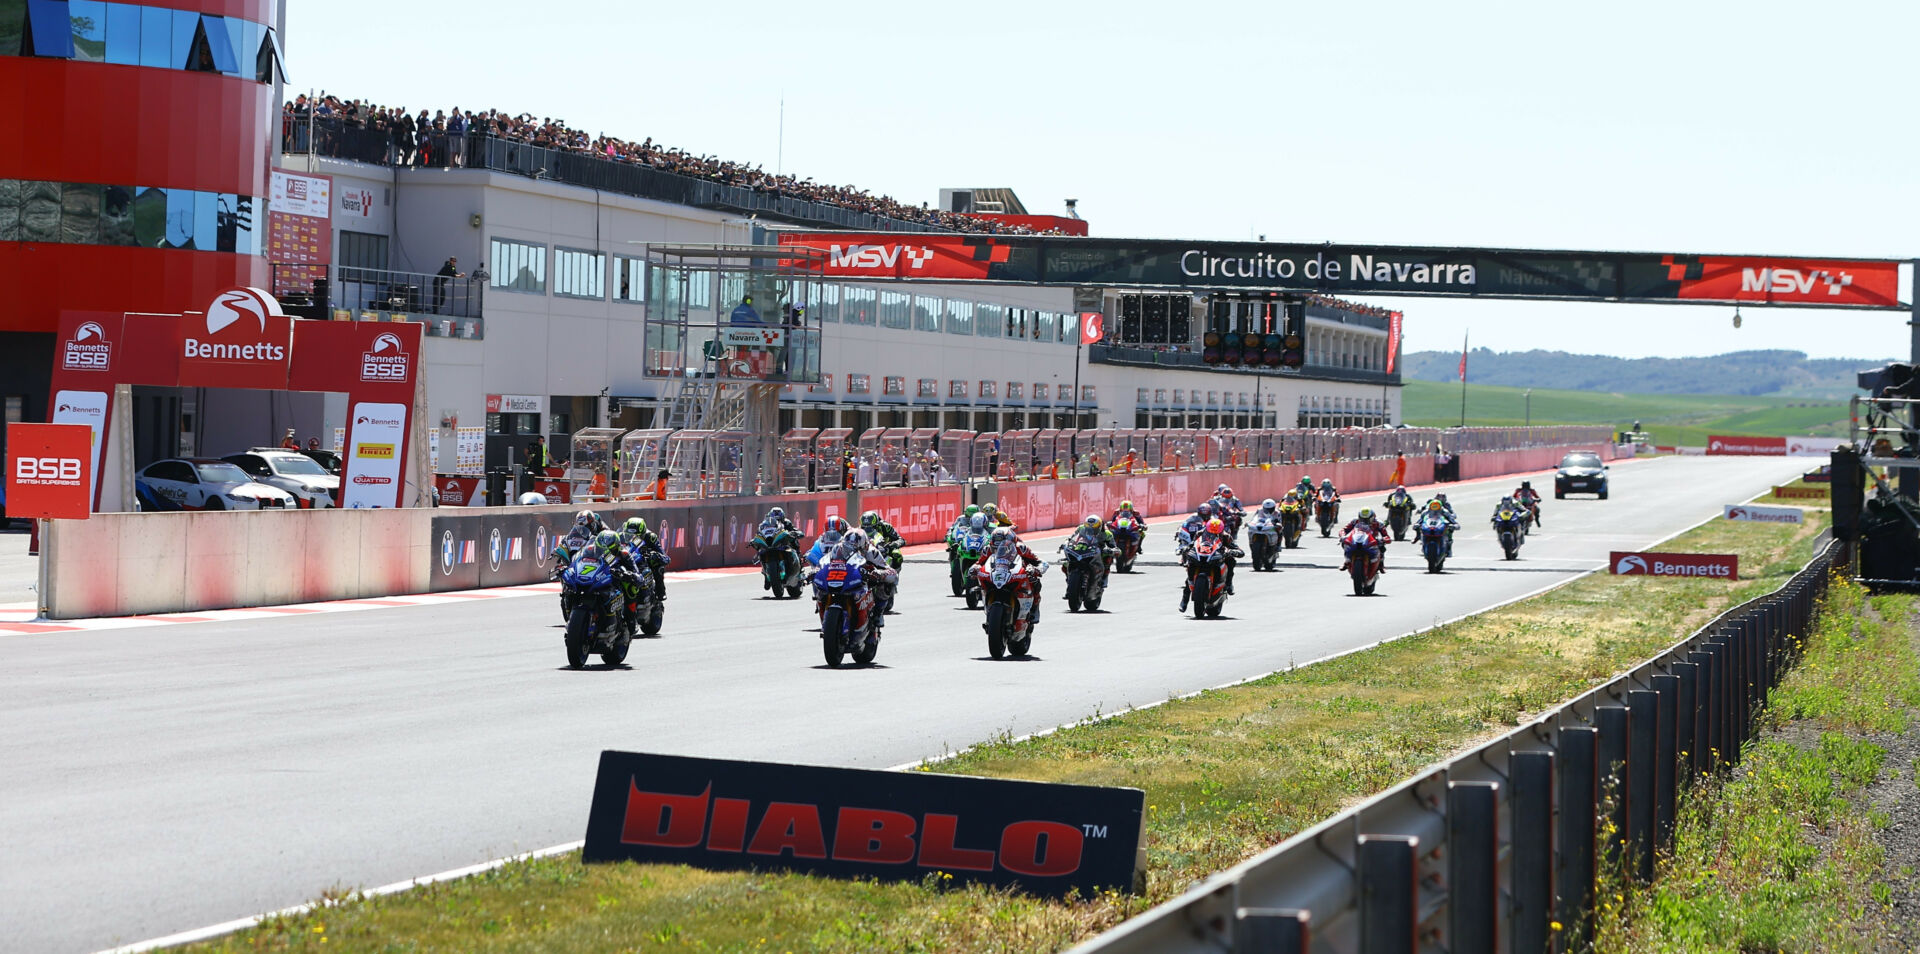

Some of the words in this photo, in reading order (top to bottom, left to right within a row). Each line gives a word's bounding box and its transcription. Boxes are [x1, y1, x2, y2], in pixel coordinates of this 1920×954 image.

[341, 197, 360, 211] Navarra
[830, 244, 902, 268] MSV
[1180, 250, 1296, 278] Circuito
[1304, 252, 1341, 280] de
[1350, 254, 1476, 285] Navarra
[1741, 267, 1818, 295] MSV
[729, 333, 760, 342] Navarra
[67, 342, 109, 353] Bennetts
[184, 338, 284, 361] Bennetts
[65, 351, 108, 365] BSB
[364, 353, 407, 364] Bennetts
[362, 363, 406, 377] BSB
[72, 406, 101, 414] Bennetts
[360, 446, 392, 456] PIRELLI
[16, 456, 82, 480] BSB
[354, 476, 389, 484] QUATTRO
[157, 486, 175, 498] Safety
[176, 488, 188, 498] Car
[442, 494, 463, 502] BSB
[866, 503, 956, 534] MOLOGATO
[1751, 511, 1798, 523] Bennetts
[579, 565, 597, 575] 7
[1654, 561, 1730, 576] Bennetts
[826, 570, 848, 581] 52
[621, 774, 1084, 877] DIABLO
[1083, 823, 1108, 839] TM
